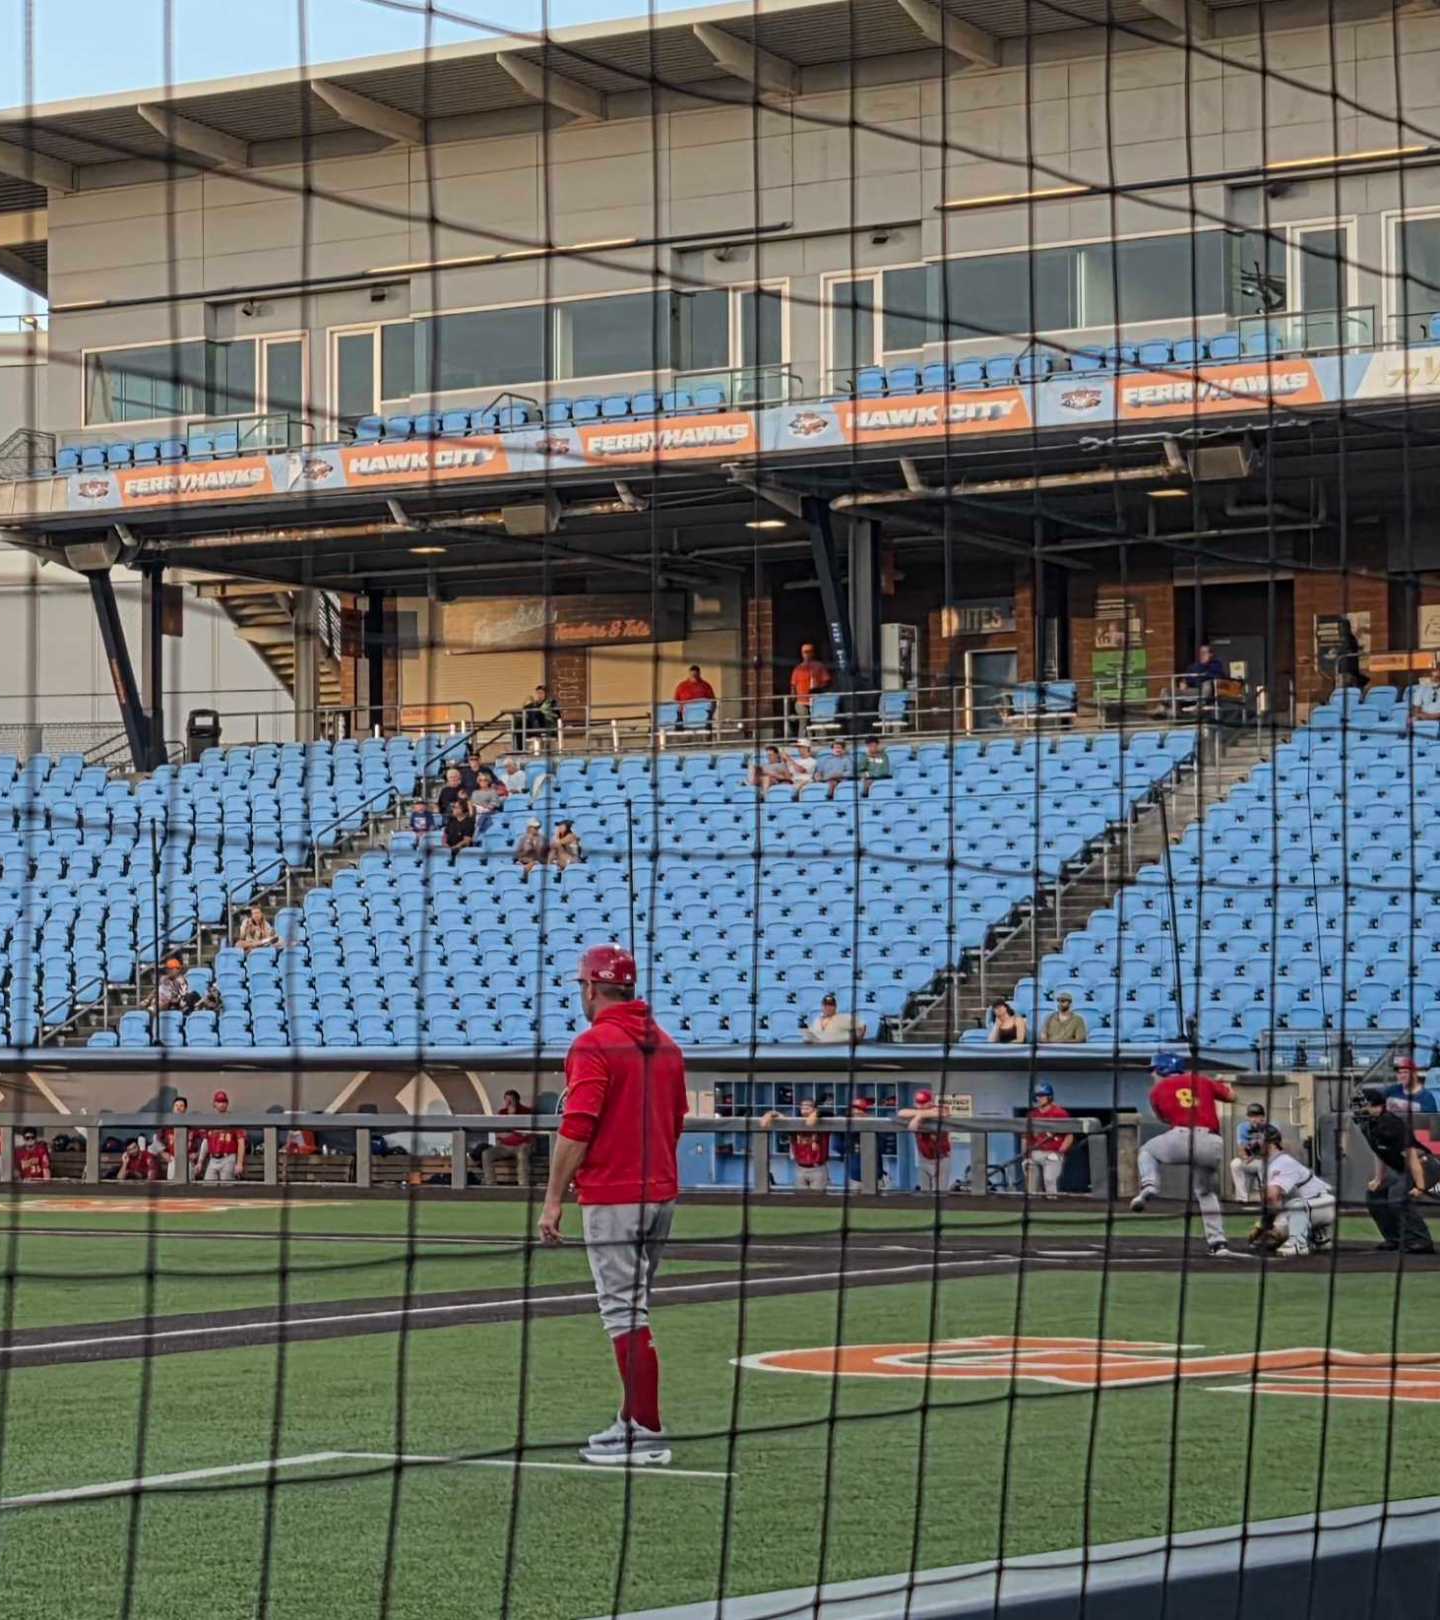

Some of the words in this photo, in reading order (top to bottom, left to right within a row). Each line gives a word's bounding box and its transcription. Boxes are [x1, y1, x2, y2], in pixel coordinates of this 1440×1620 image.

[1122, 372, 1309, 407] FERRYHAWKS
[846, 405, 938, 430] HAWK
[944, 400, 1018, 423] CITY
[588, 424, 749, 455] FERRYHAWKS
[349, 451, 428, 475] HAWK
[435, 446, 496, 469] CITY
[124, 466, 265, 497] FERRYHAWKS
